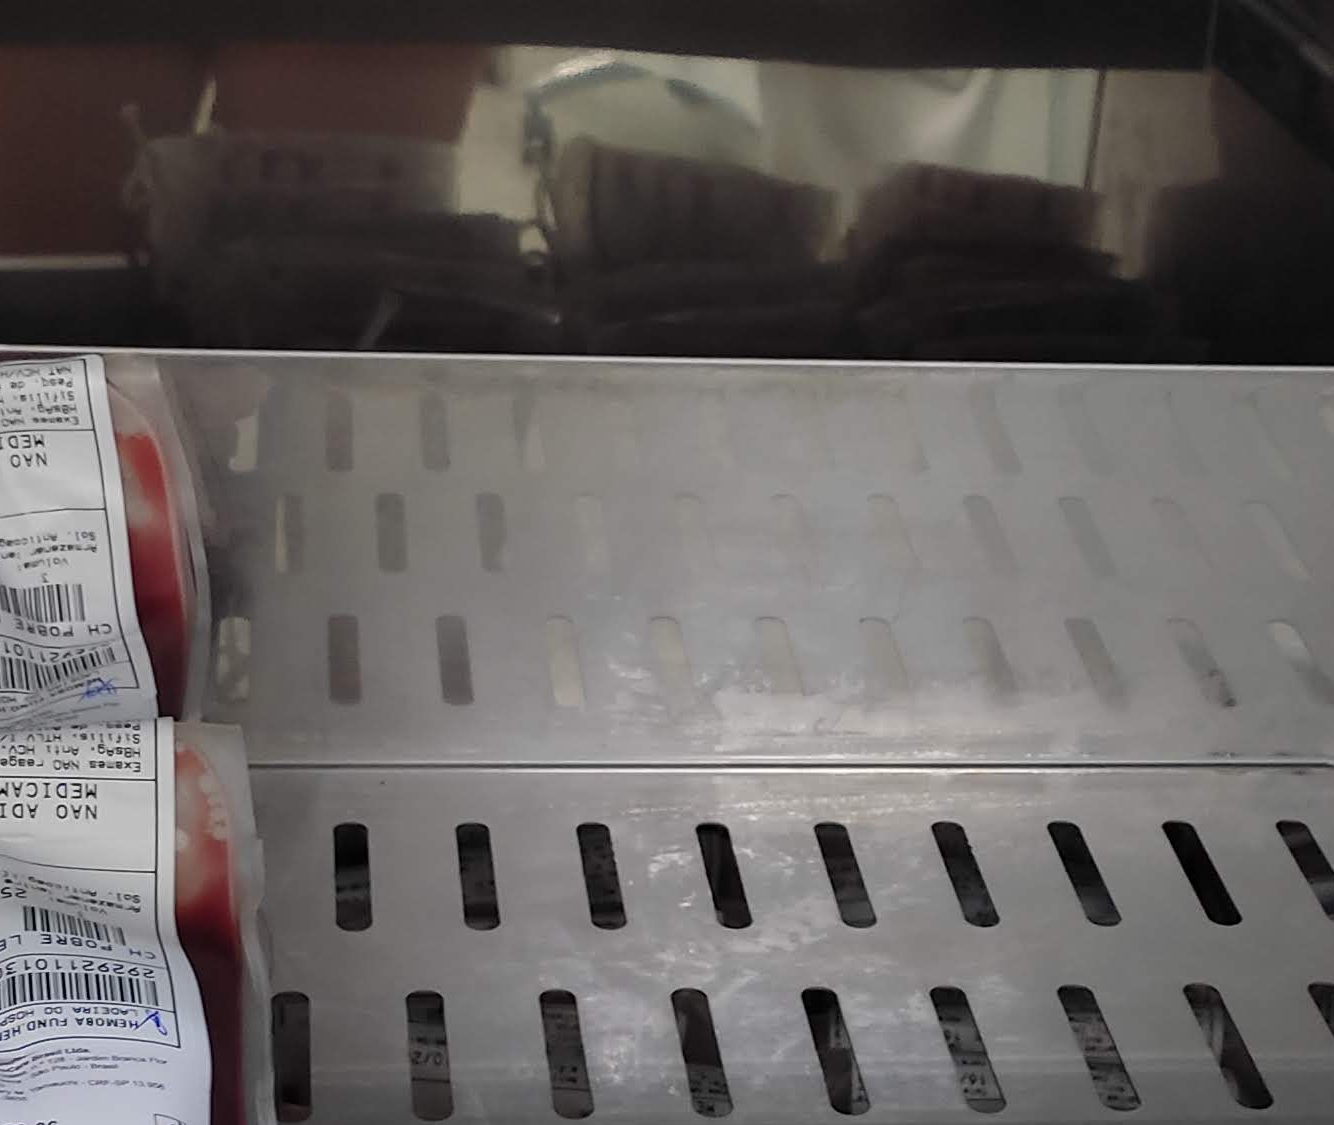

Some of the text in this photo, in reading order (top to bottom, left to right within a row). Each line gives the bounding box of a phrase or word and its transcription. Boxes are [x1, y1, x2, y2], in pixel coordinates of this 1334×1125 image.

[0, 416, 26, 429] NAO
[31, 414, 81, 427] Exames
[9, 451, 48, 468] NAO
[14, 617, 74, 638] POBRE
[86, 623, 114, 636] CH
[24, 732, 62, 744] HTLV
[44, 744, 80, 756] Anti
[52, 759, 81, 772] NAO
[88, 760, 142, 773] Exames
[54, 803, 99, 821] NAO
[128, 947, 156, 961] CH
[42, 1006, 63, 1016] DO
[72, 1006, 139, 1017] LADEIRA
[74, 1017, 139, 1029] HEMOBA
